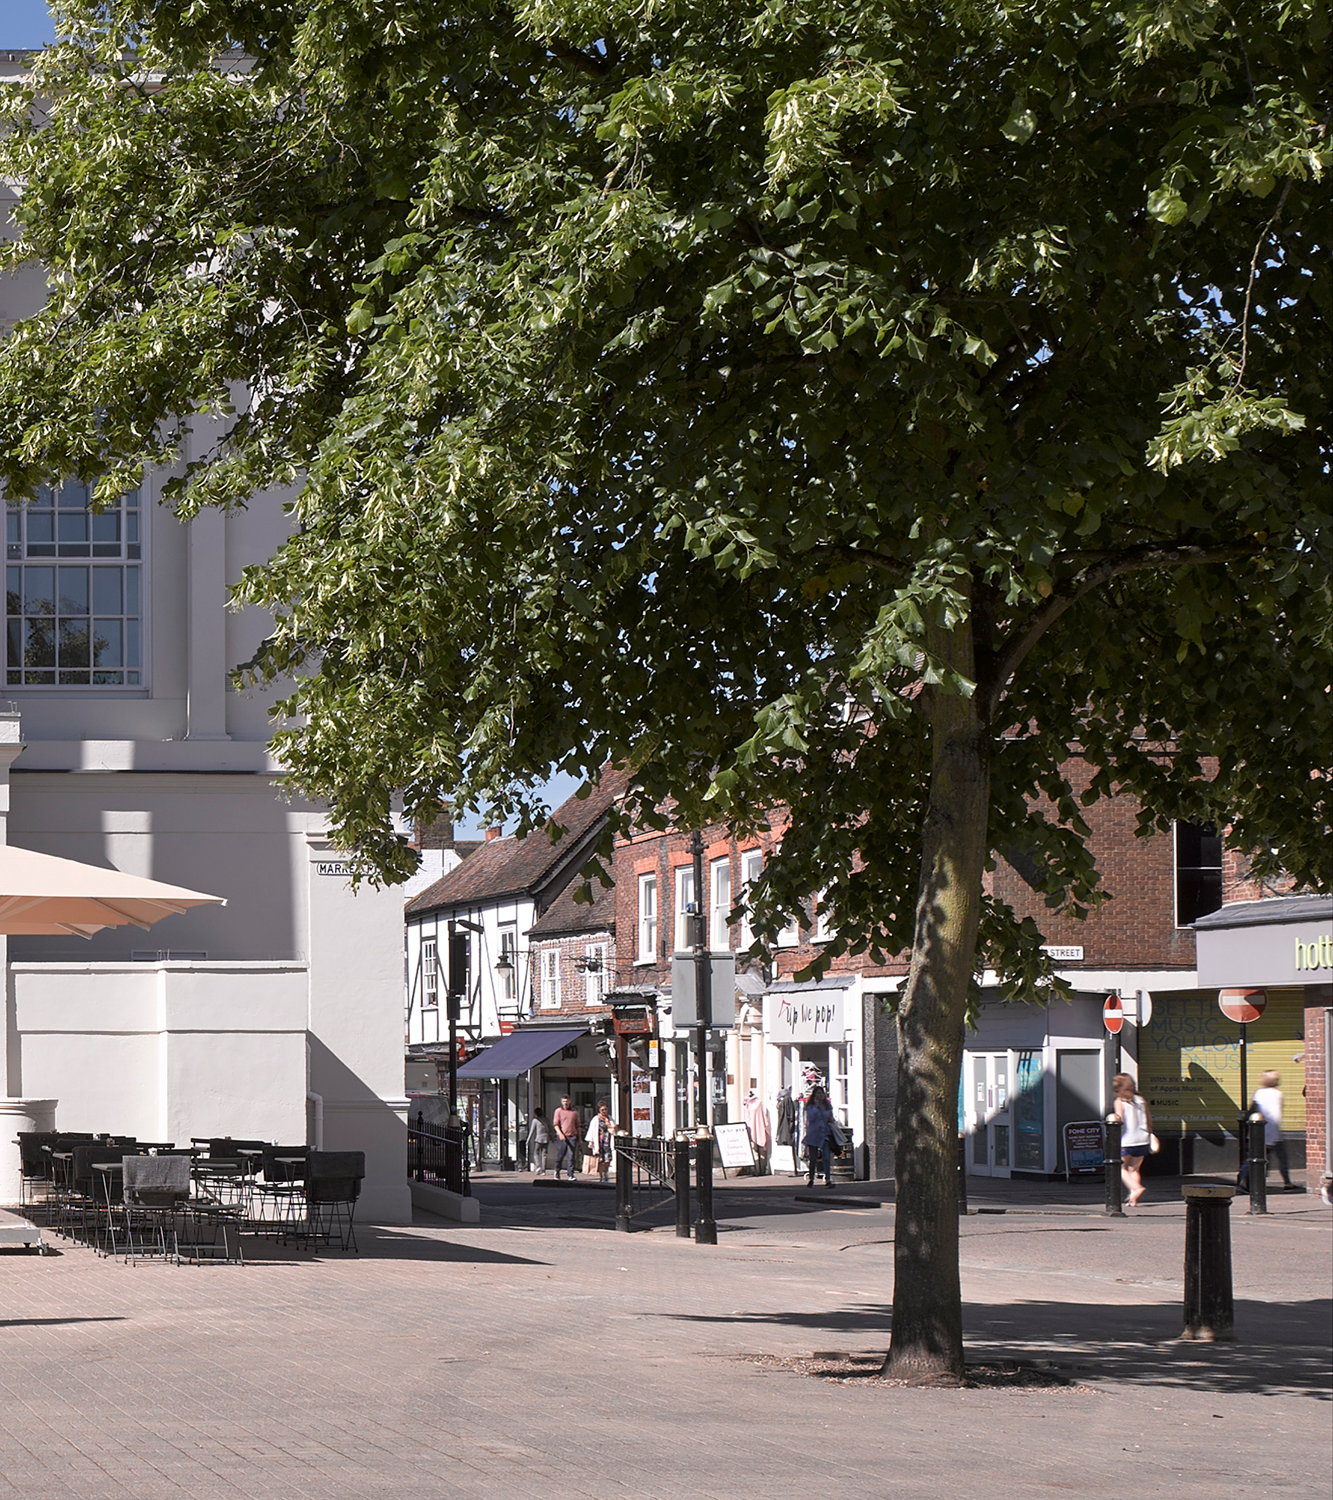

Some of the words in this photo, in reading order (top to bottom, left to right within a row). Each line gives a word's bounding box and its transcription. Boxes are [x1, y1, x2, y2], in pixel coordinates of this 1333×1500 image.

[1050, 949, 1081, 957] STREET
[1153, 999, 1191, 1016] GET
[1151, 1017, 1219, 1034] MUSIC
[1151, 1036, 1196, 1051] YOU
[1202, 1036, 1255, 1052] LOVE
[1176, 1053, 1208, 1070] ON
[1214, 1053, 1241, 1070] US
